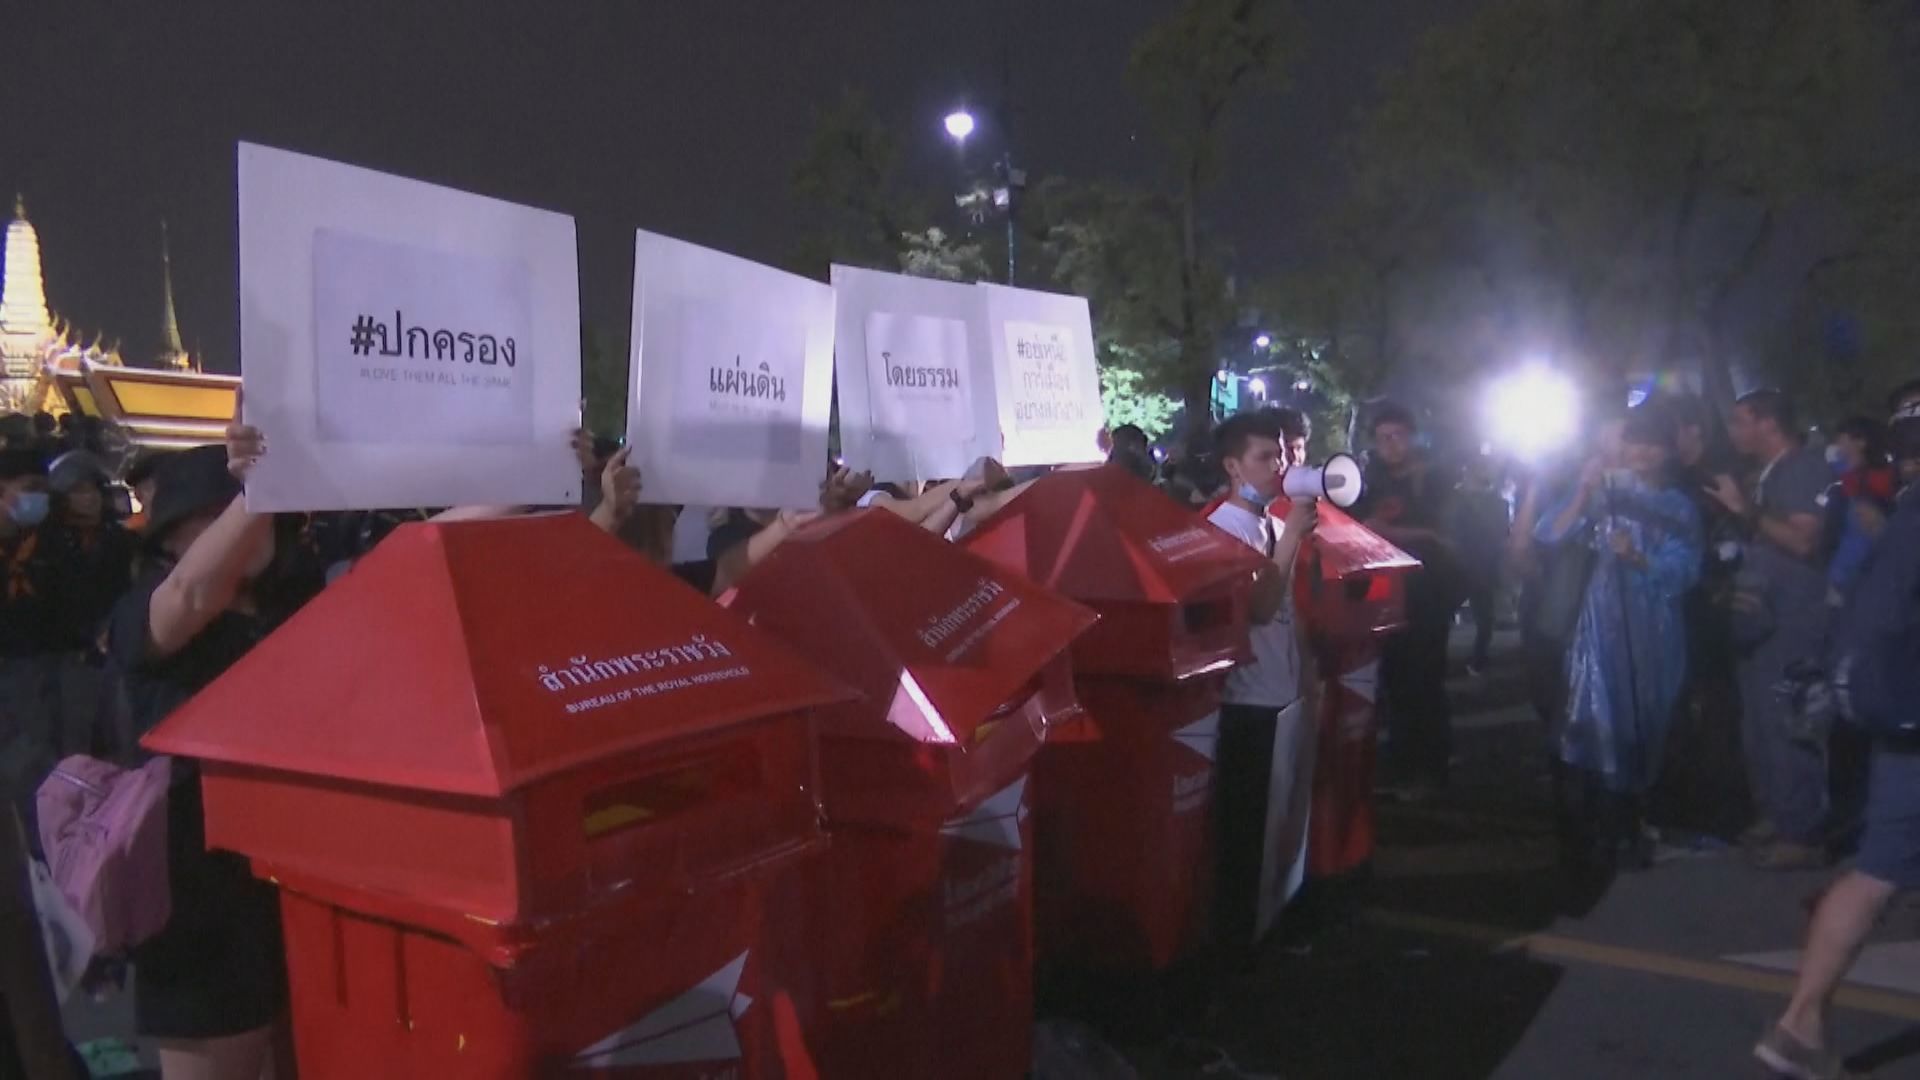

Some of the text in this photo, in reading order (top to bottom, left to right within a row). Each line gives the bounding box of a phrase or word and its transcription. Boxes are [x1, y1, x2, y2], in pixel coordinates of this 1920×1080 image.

[350, 310, 516, 367] #ปกครอง
[403, 369, 435, 384] THEM
[437, 372, 456, 386] ALL
[710, 354, 786, 402] แผ่นดิน
[882, 352, 959, 388] โดยธรรม
[538, 633, 732, 691] สำนักพระราชวัง
[564, 694, 617, 714] BUREAU
[617, 688, 632, 702] OF
[632, 683, 657, 698] THE
[657, 676, 692, 692] ROYAL
